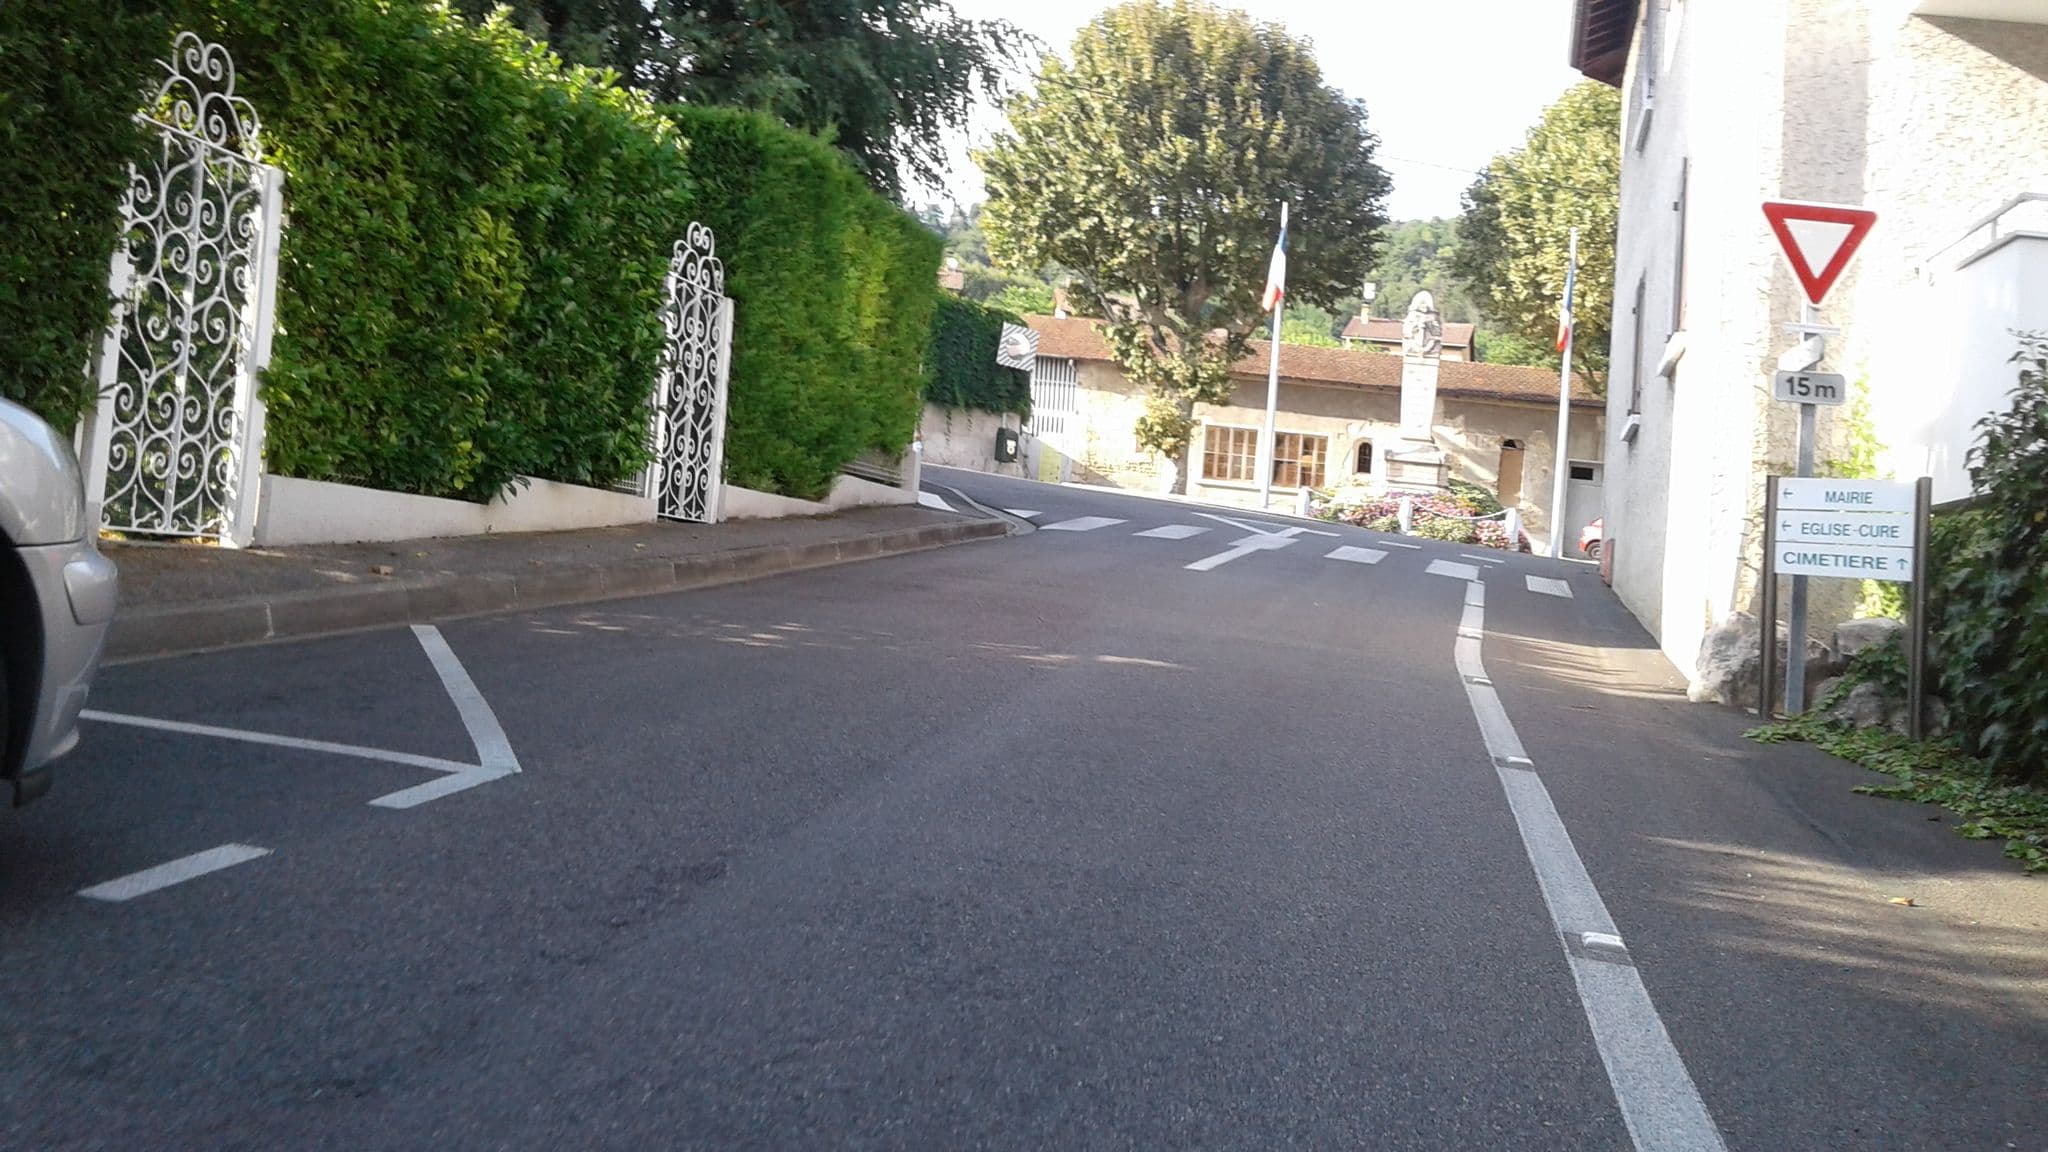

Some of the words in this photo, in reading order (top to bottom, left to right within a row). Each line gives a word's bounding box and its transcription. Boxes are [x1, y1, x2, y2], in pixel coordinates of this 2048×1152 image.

[1785, 376, 1811, 397] 15
[1824, 491, 1873, 504] MAIRIE
[1783, 551, 1888, 570] CIMETIERE
